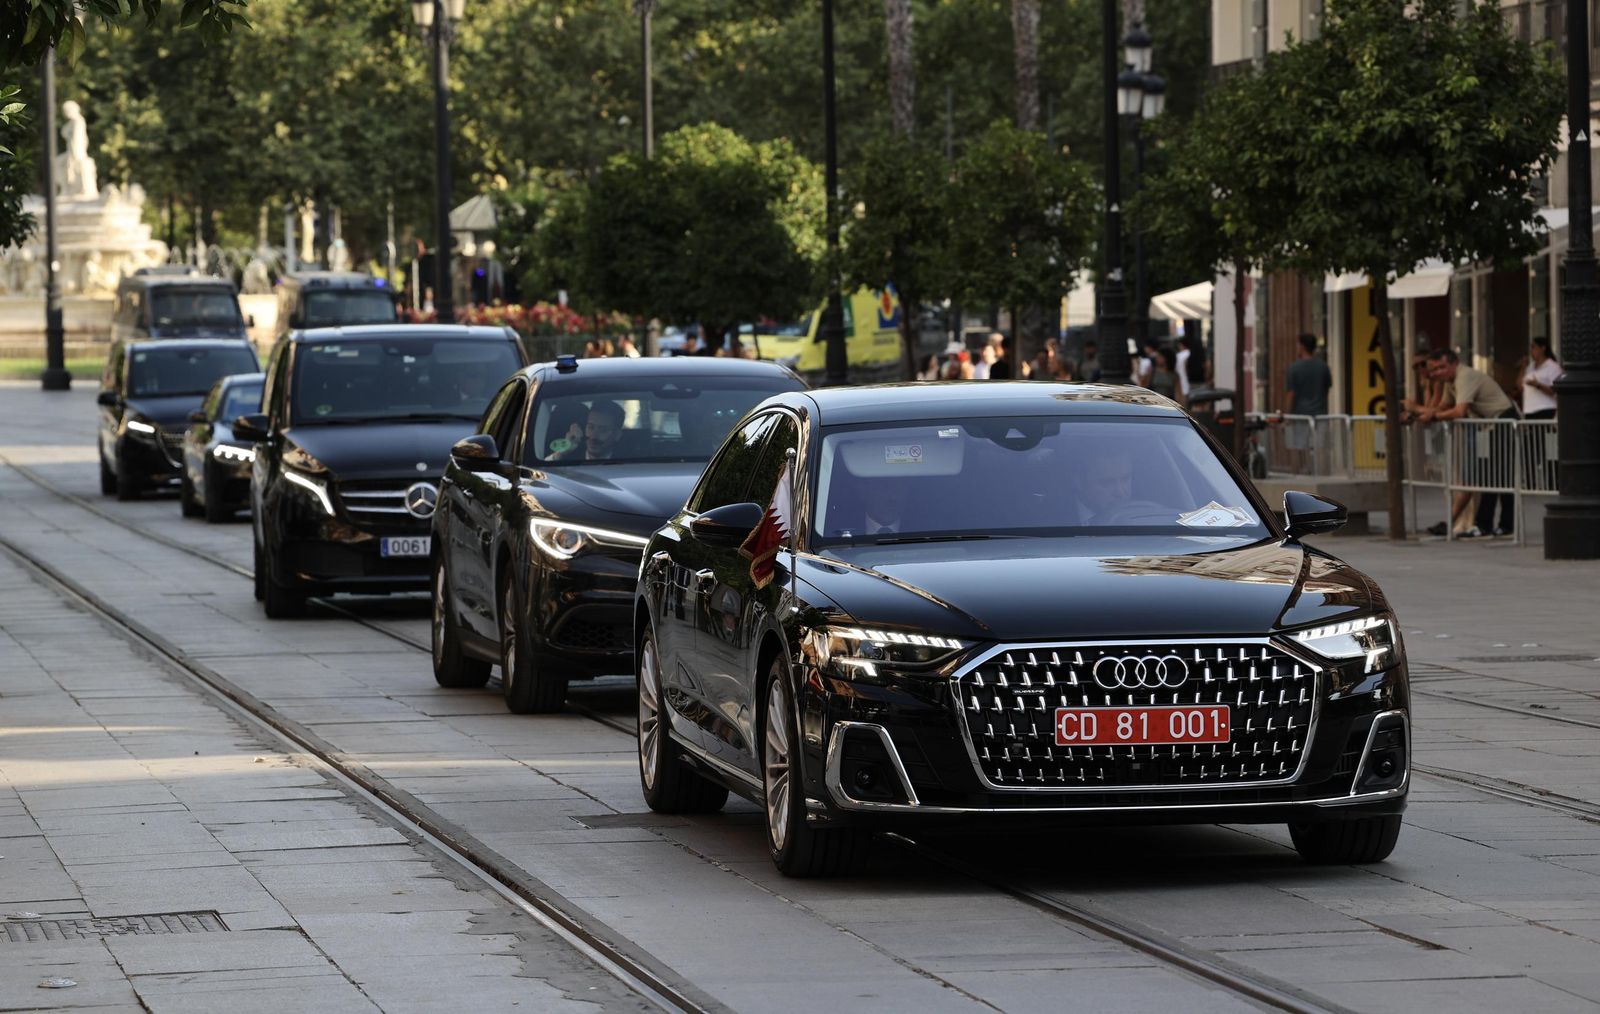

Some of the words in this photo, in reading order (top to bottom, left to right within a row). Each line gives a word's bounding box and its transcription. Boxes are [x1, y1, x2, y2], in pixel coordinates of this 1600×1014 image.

[391, 539, 427, 553] 0061
[1061, 712, 1097, 740] CD
[1116, 711, 1148, 740] 81
[1169, 709, 1219, 739] 001
